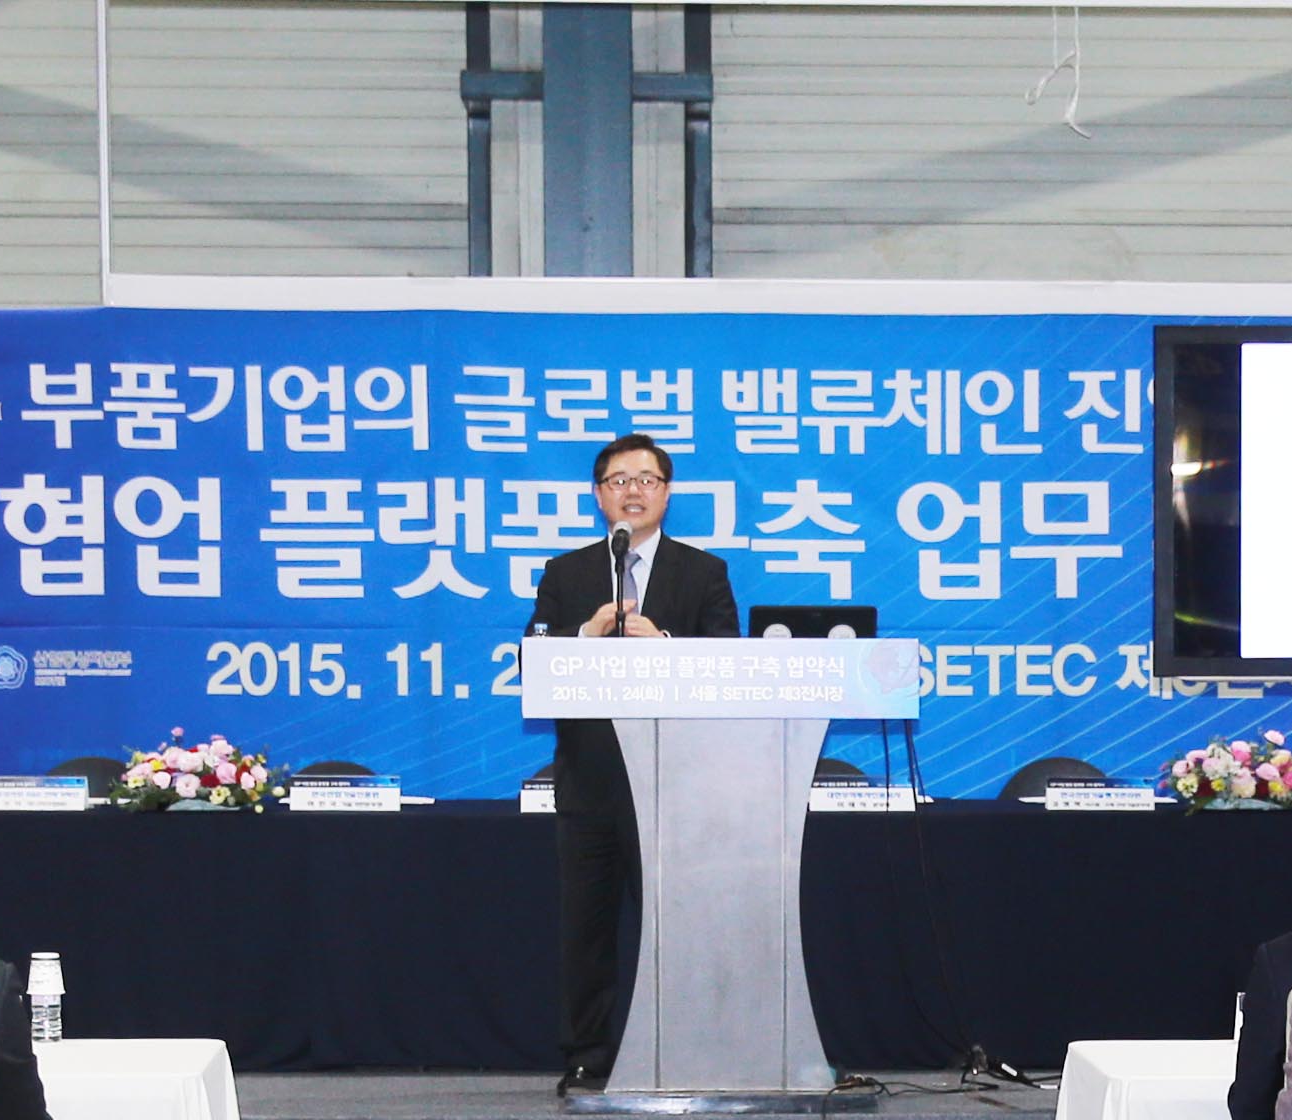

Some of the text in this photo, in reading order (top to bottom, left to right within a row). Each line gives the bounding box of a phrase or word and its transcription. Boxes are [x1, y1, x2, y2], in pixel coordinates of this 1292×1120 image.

[455, 365, 696, 454] 글로벌
[722, 367, 1043, 456] 밸류체인
[1064, 369, 1154, 455] 진
[259, 477, 605, 600] 플랫폼
[896, 481, 1123, 600] 업무
[206, 641, 361, 699] 2015.
[386, 642, 469, 698] 11.
[632, 656, 672, 679] 협업
[676, 656, 736, 679] 플랫폼
[741, 656, 780, 679] 구축
[786, 656, 845, 679] 협약식
[688, 685, 718, 703] 서울
[722, 686, 773, 702] SETEC
[778, 685, 844, 703] 제3전시장
